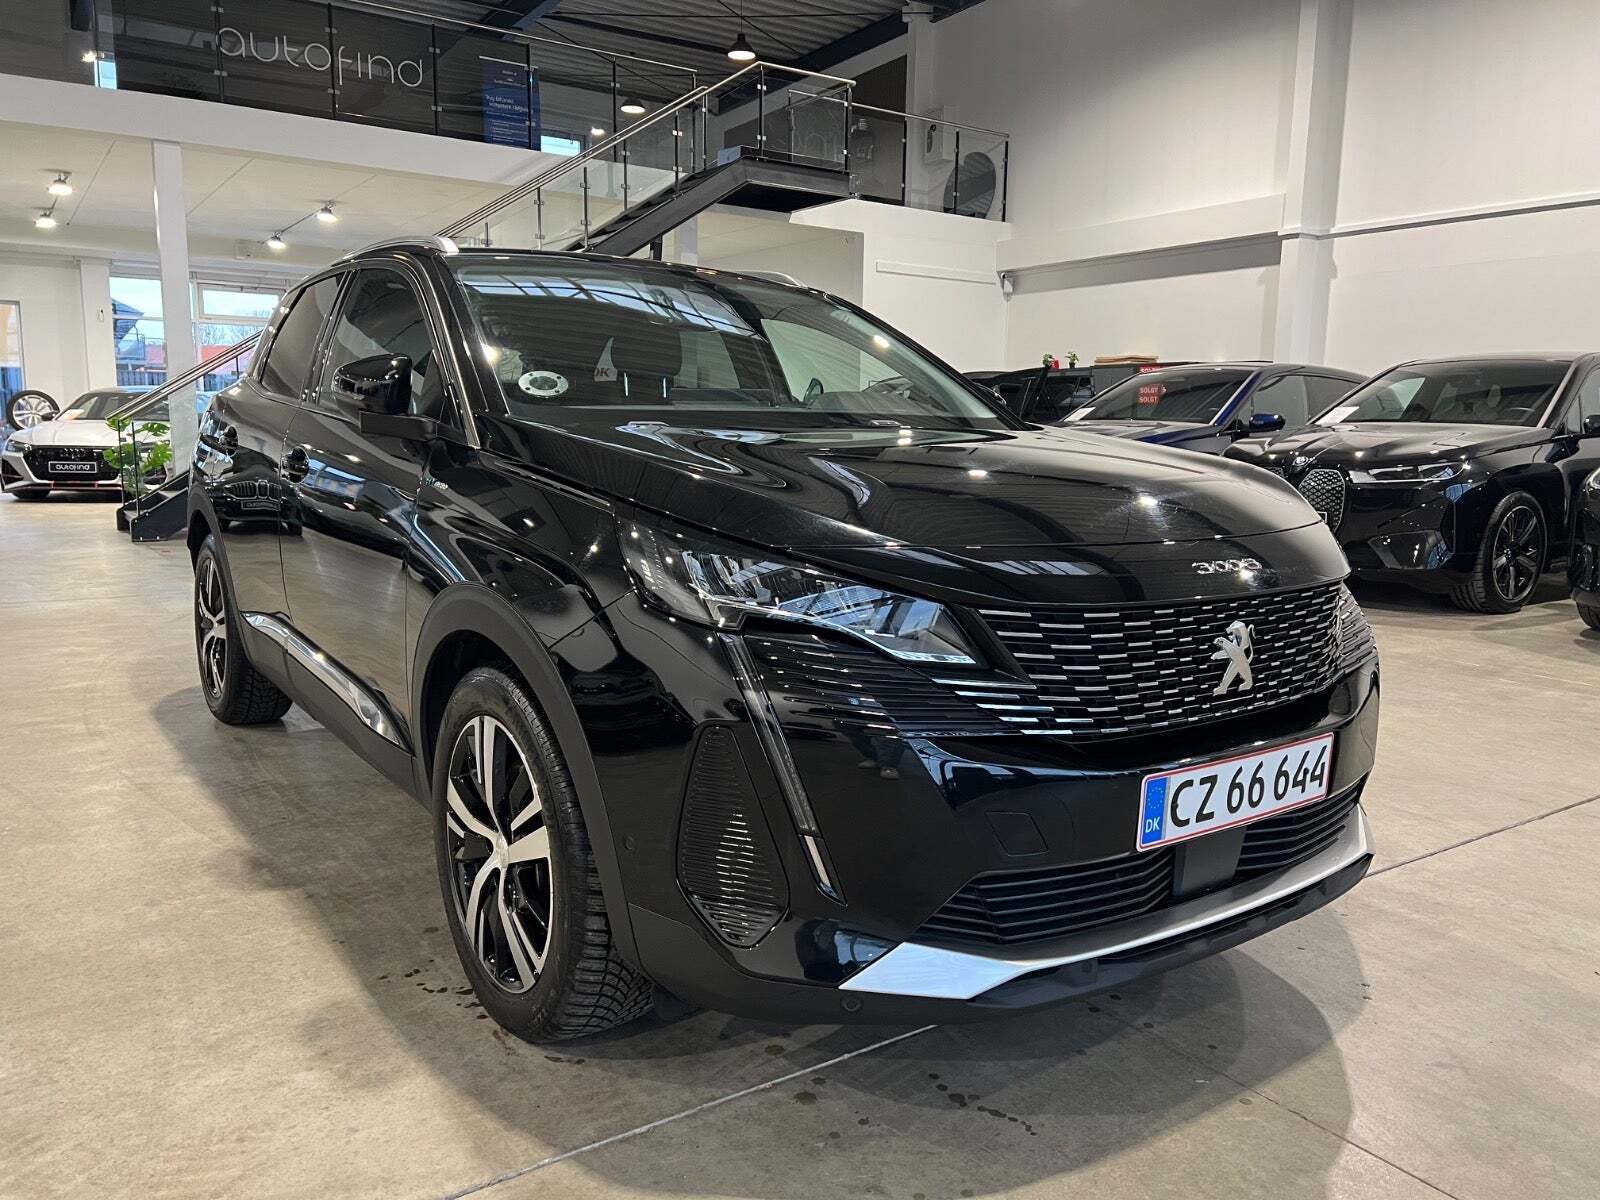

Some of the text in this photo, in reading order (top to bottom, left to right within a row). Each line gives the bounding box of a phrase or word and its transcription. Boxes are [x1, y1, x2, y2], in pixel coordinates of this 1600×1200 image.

[215, 27, 423, 87] autofind
[1170, 744, 1328, 828] CZ 66 644
[1145, 815, 1161, 834] DK
